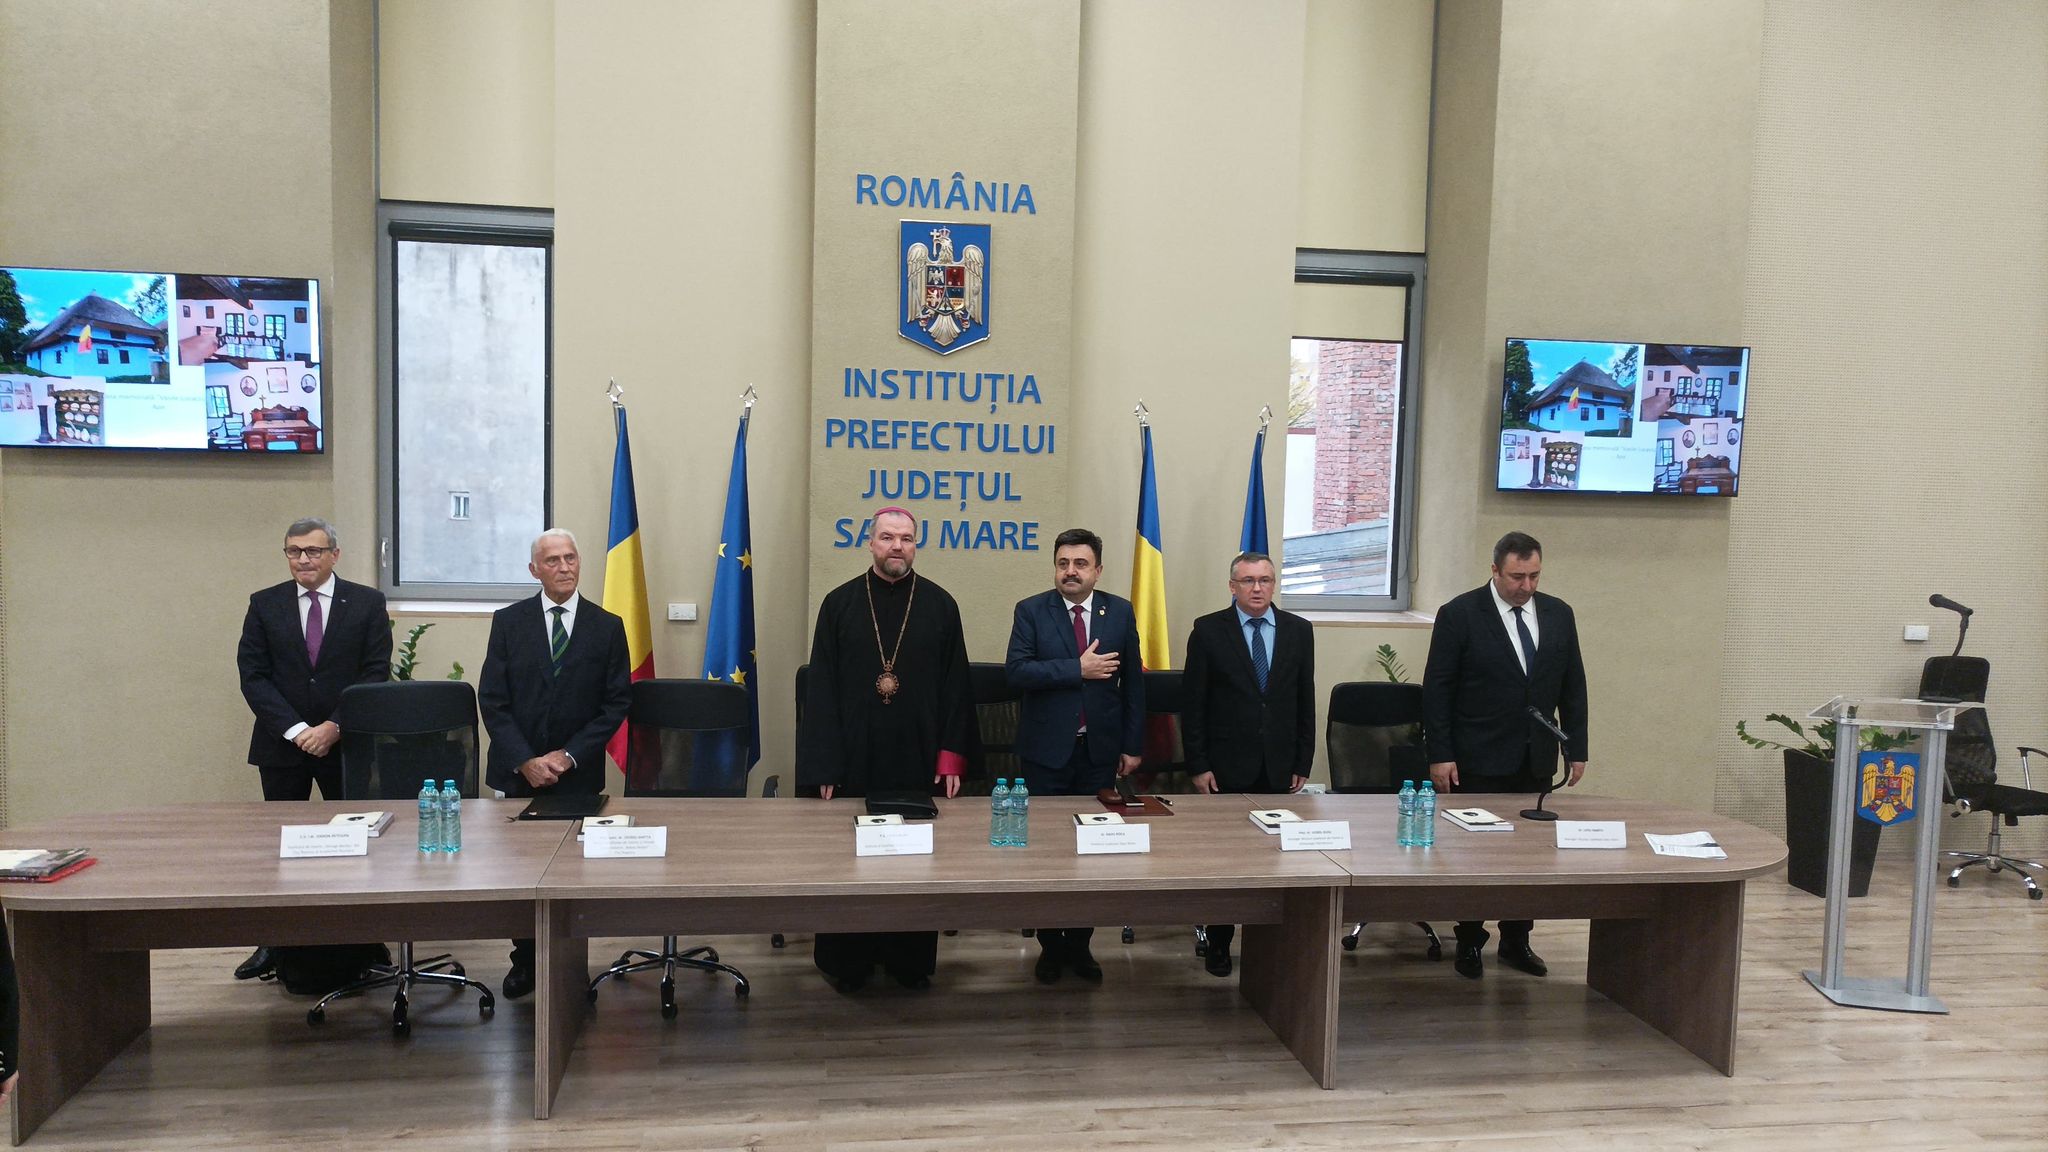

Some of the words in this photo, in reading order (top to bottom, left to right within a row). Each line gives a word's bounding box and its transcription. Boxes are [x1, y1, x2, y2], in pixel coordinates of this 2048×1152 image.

[856, 172, 1037, 214] ROMÂNIA
[844, 367, 1041, 413] INSTITUȚIA
[825, 418, 1055, 454] PREFECTULUI
[862, 469, 1022, 511] JUDEȚUL
[834, 518, 929, 549] SAU
[939, 520, 1040, 551] MARE
